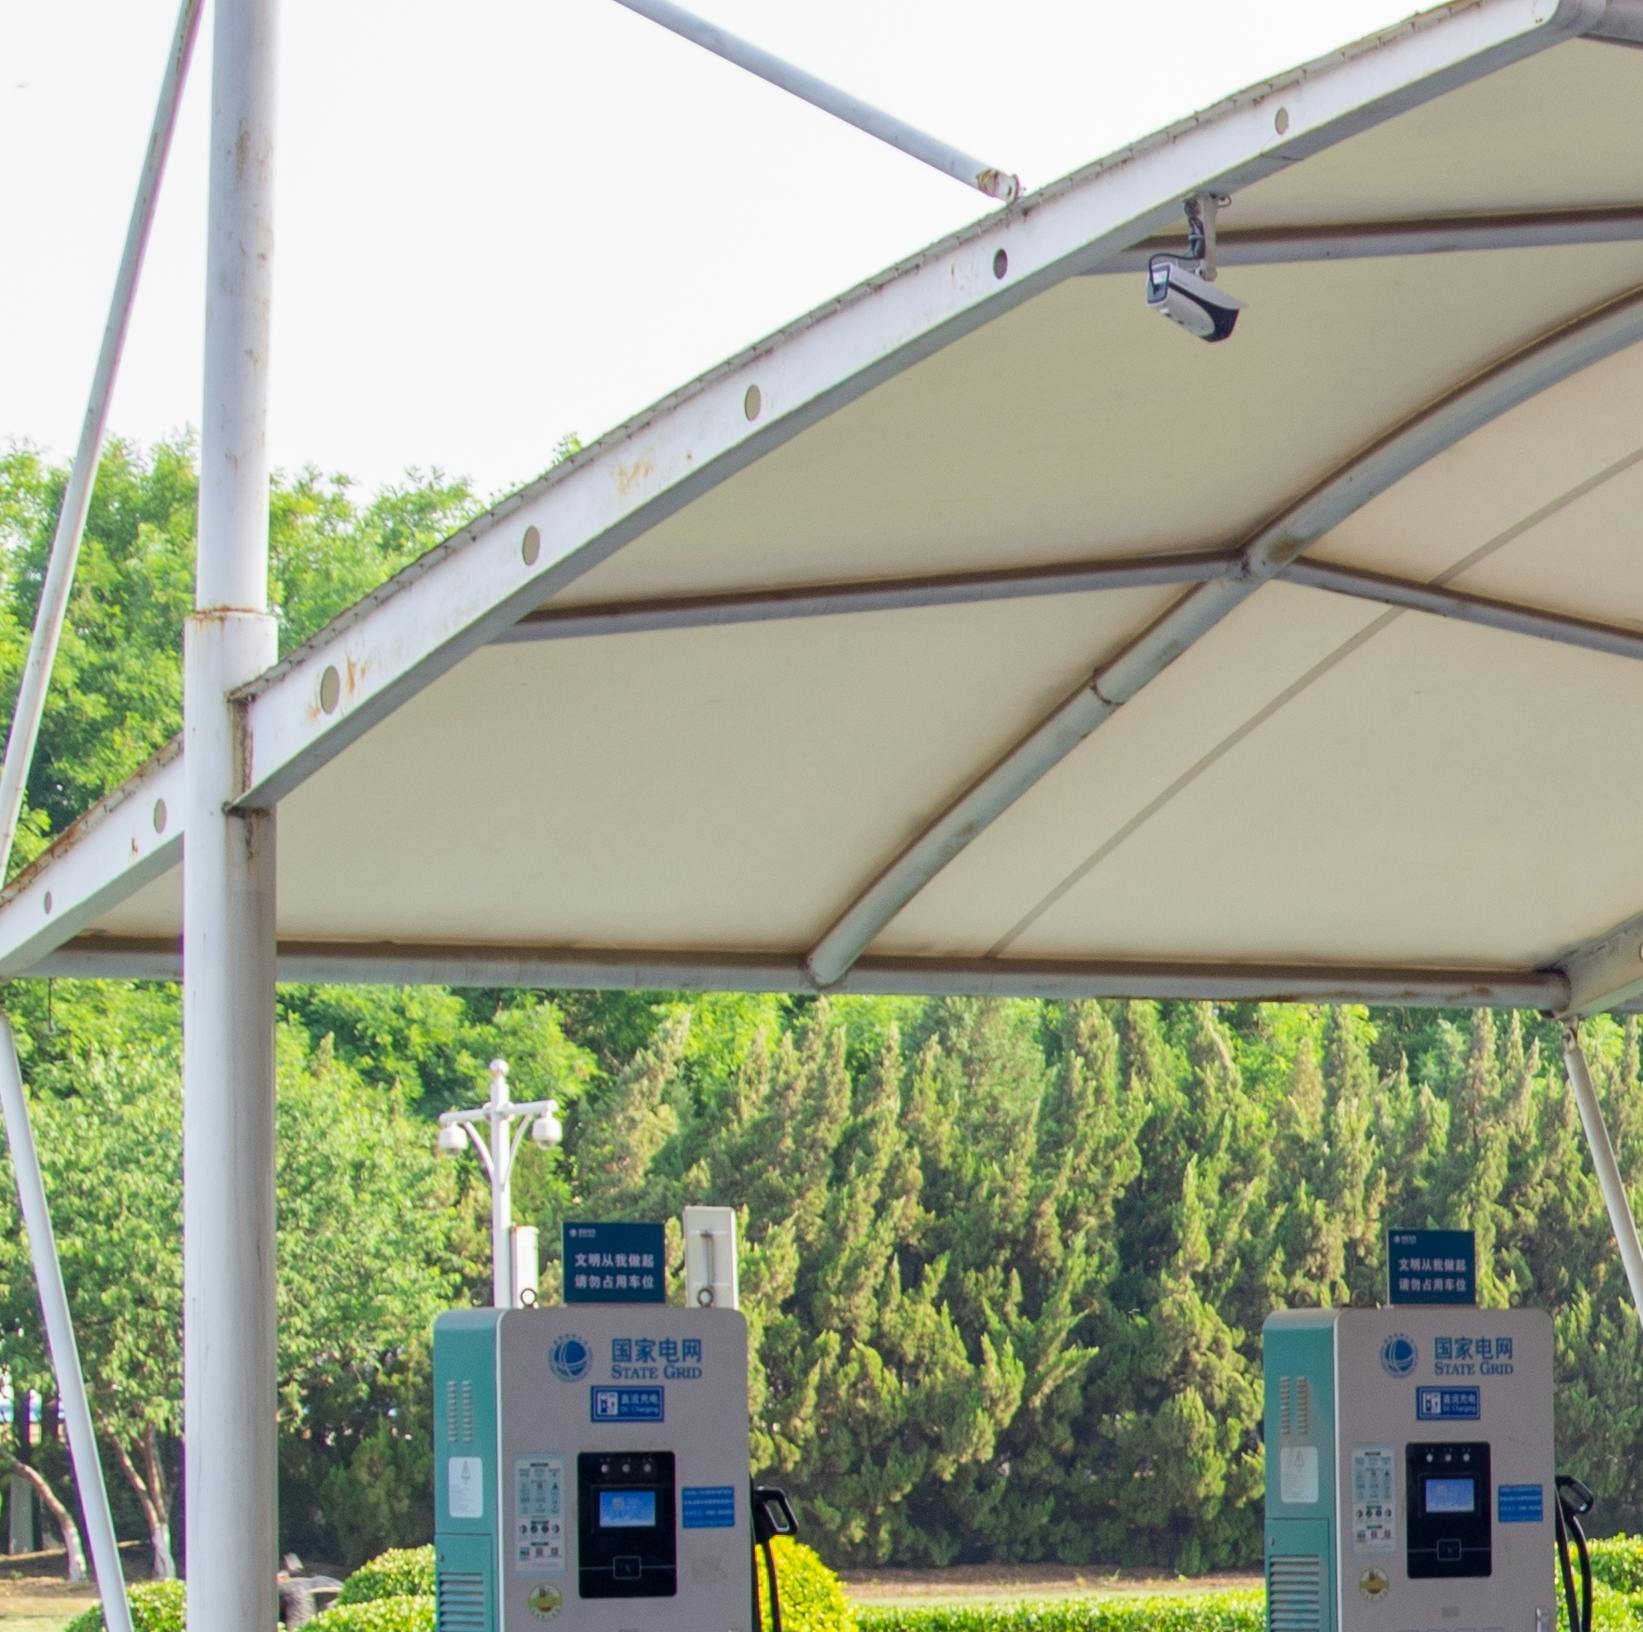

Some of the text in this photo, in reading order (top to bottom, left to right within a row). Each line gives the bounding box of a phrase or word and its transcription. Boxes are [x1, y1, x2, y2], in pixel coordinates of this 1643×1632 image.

[573, 1252, 655, 1268] 文明从我做起
[1398, 1258, 1467, 1272] 文明从我做起
[574, 1274, 655, 1290] 请勿占用车位
[1398, 1278, 1467, 1292] 请勿占用车位
[611, 1337, 702, 1363] 国家电网
[1434, 1336, 1513, 1360] 国家电网
